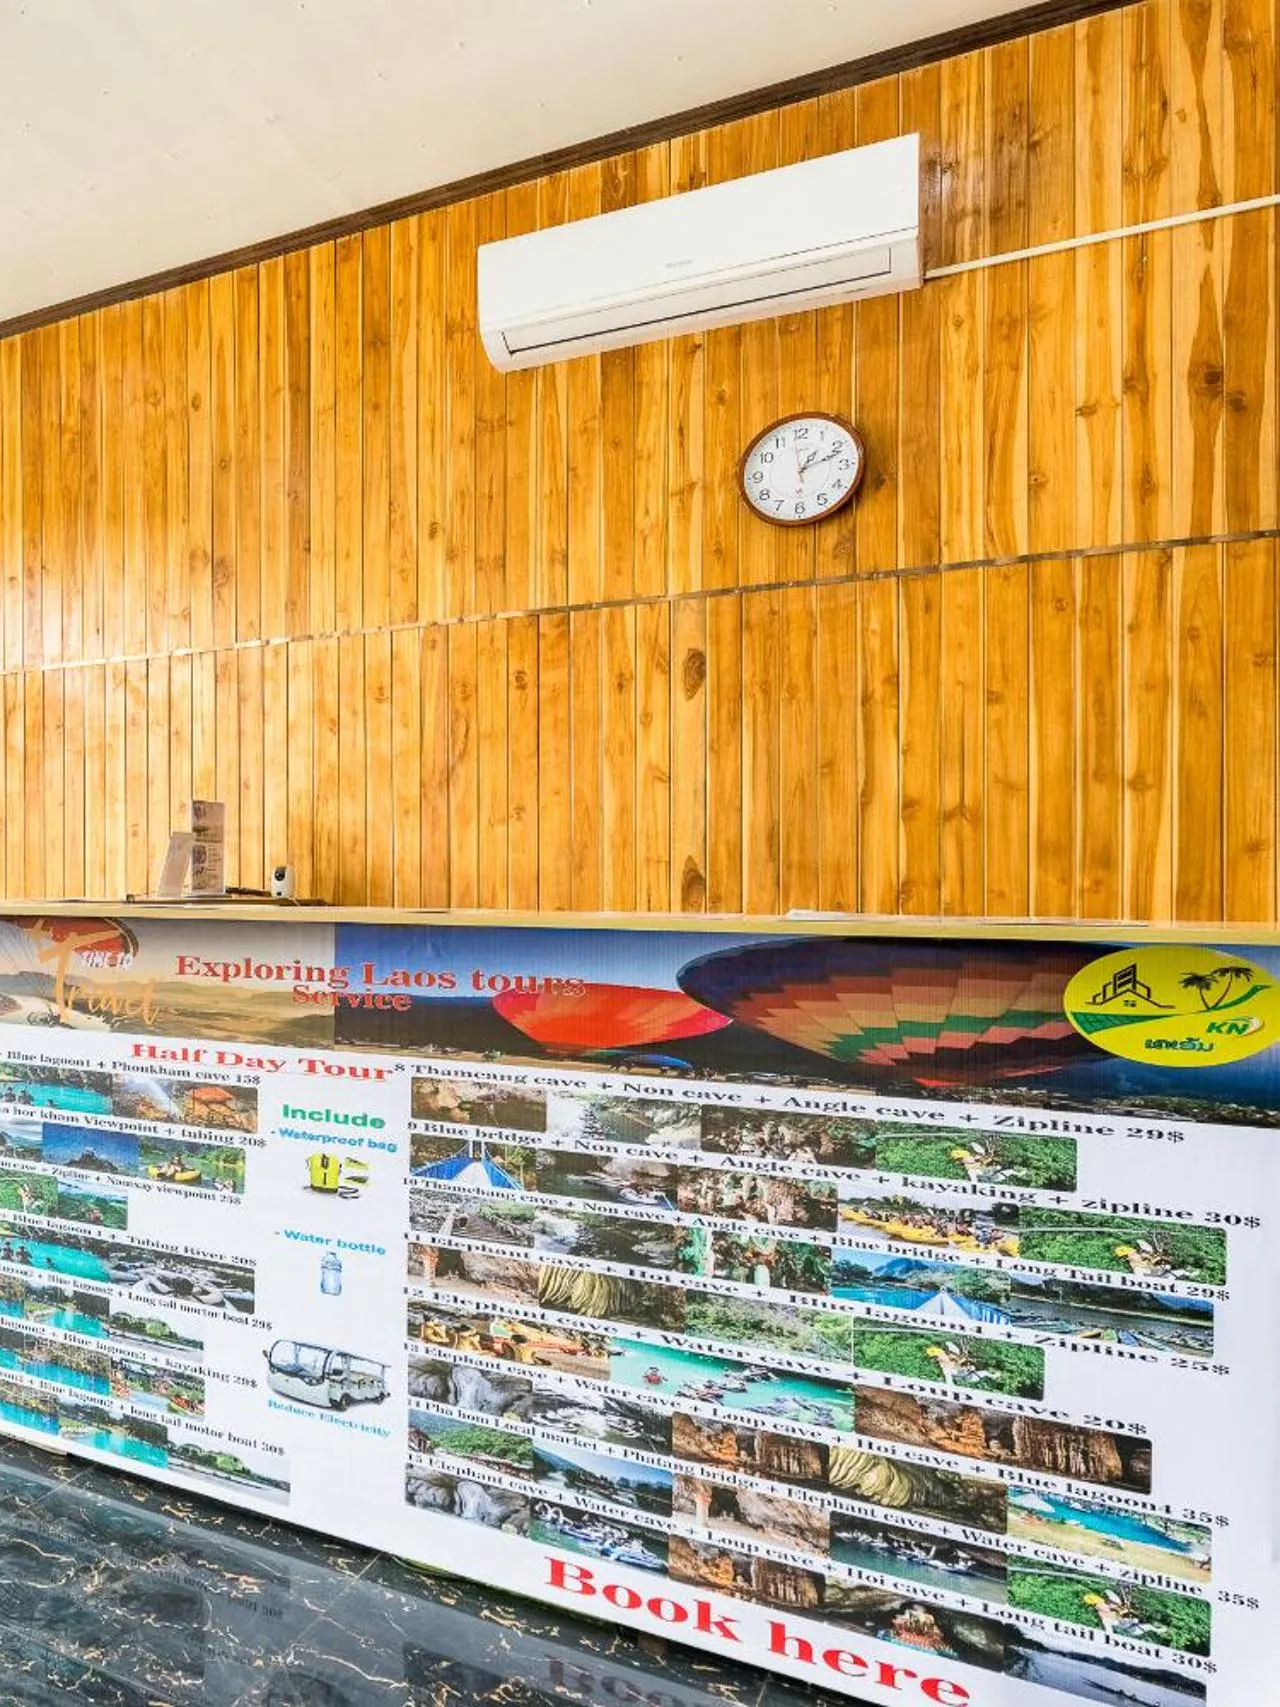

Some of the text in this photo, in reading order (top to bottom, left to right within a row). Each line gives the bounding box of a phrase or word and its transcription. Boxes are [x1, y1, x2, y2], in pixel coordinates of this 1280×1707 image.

[775, 438, 785, 448] 11
[794, 428, 808, 439] 12
[760, 452, 774, 464] 10
[838, 459, 849, 470] 3
[752, 471, 763, 483] 9
[759, 489, 770, 500] 8
[775, 500, 784, 511] 7
[795, 502, 806, 514] 6
[817, 493, 828, 505] 5
[175, 954, 587, 997] Exploring Laos tours
[292, 984, 413, 1012] Service
[1206, 1021, 1250, 1035] KN
[7, 1049, 36, 1062] Blue
[195, 1071, 230, 1082] cave
[132, 1043, 394, 1081] Half Day Tour
[282, 1103, 386, 1130] Include
[534, 1076, 587, 1088] cave
[623, 1082, 673, 1096] Non
[682, 1089, 741, 1102] cave
[782, 1096, 866, 1114] Angle
[876, 1106, 945, 1121] cave
[992, 1114, 1115, 1136] Zipline
[1126, 1125, 1184, 1144] 29$
[84, 1114, 158, 1134] Viewpoint
[181, 1127, 234, 1146] tubing
[278, 1127, 399, 1153] Waterproof bag
[424, 1122, 468, 1136] Blue
[475, 1128, 542, 1145] bridge
[574, 1139, 618, 1154] Non
[626, 1147, 678, 1161] cave
[720, 1155, 792, 1174] Angle
[801, 1167, 861, 1182] cave
[901, 1176, 1037, 1205] kayaking
[1082, 1198, 1193, 1220] zipline
[1204, 1210, 1261, 1230] 30$
[284, 1228, 387, 1256] Water bottle
[520, 1194, 557, 1207] cave
[582, 1201, 618, 1215] Non
[624, 1209, 664, 1222] cave
[692, 1216, 748, 1233] Angle
[753, 1227, 799, 1241] cave
[831, 1235, 880, 1252] Blue
[888, 1243, 960, 1263] bridge
[996, 1258, 1057, 1279] Long
[1064, 1267, 1111, 1284] Tail
[1122, 1275, 1178, 1294] boat
[1186, 1284, 1229, 1302] 29$
[538, 1255, 591, 1270] cave
[680, 1278, 738, 1294] cave
[1034, 1333, 1157, 1364] Zipline
[557, 1316, 618, 1335] cave
[660, 1333, 750, 1360] Water
[759, 1354, 830, 1375] cave
[883, 1375, 973, 1405] Loup
[985, 1397, 1070, 1421] cave
[1083, 1412, 1147, 1437] 20$
[267, 1399, 316, 1419] Reduce
[424, 1346, 502, 1371] Elephant
[507, 1365, 547, 1381] cave
[574, 1378, 629, 1398] Water
[636, 1393, 680, 1409] cave
[712, 1407, 766, 1430] Loup
[772, 1422, 822, 1440] cave
[858, 1438, 896, 1456] Hoi
[905, 1450, 959, 1469] cave
[998, 1467, 1056, 1490] Blue
[1182, 1506, 1229, 1529] 35$
[494, 1417, 536, 1436] Local
[541, 1430, 597, 1451] market
[700, 1466, 759, 1490] bridge
[787, 1486, 877, 1519] Elephant
[884, 1512, 929, 1531] cave
[961, 1527, 1027, 1555] Water
[1033, 1547, 1085, 1568] cave
[1120, 1568, 1202, 1597] zipline
[429, 1457, 1217, 1675] Elephant cave Water cave Loup cave Hoi cave Long tail boat 30$
[544, 1555, 972, 1707] Book here
